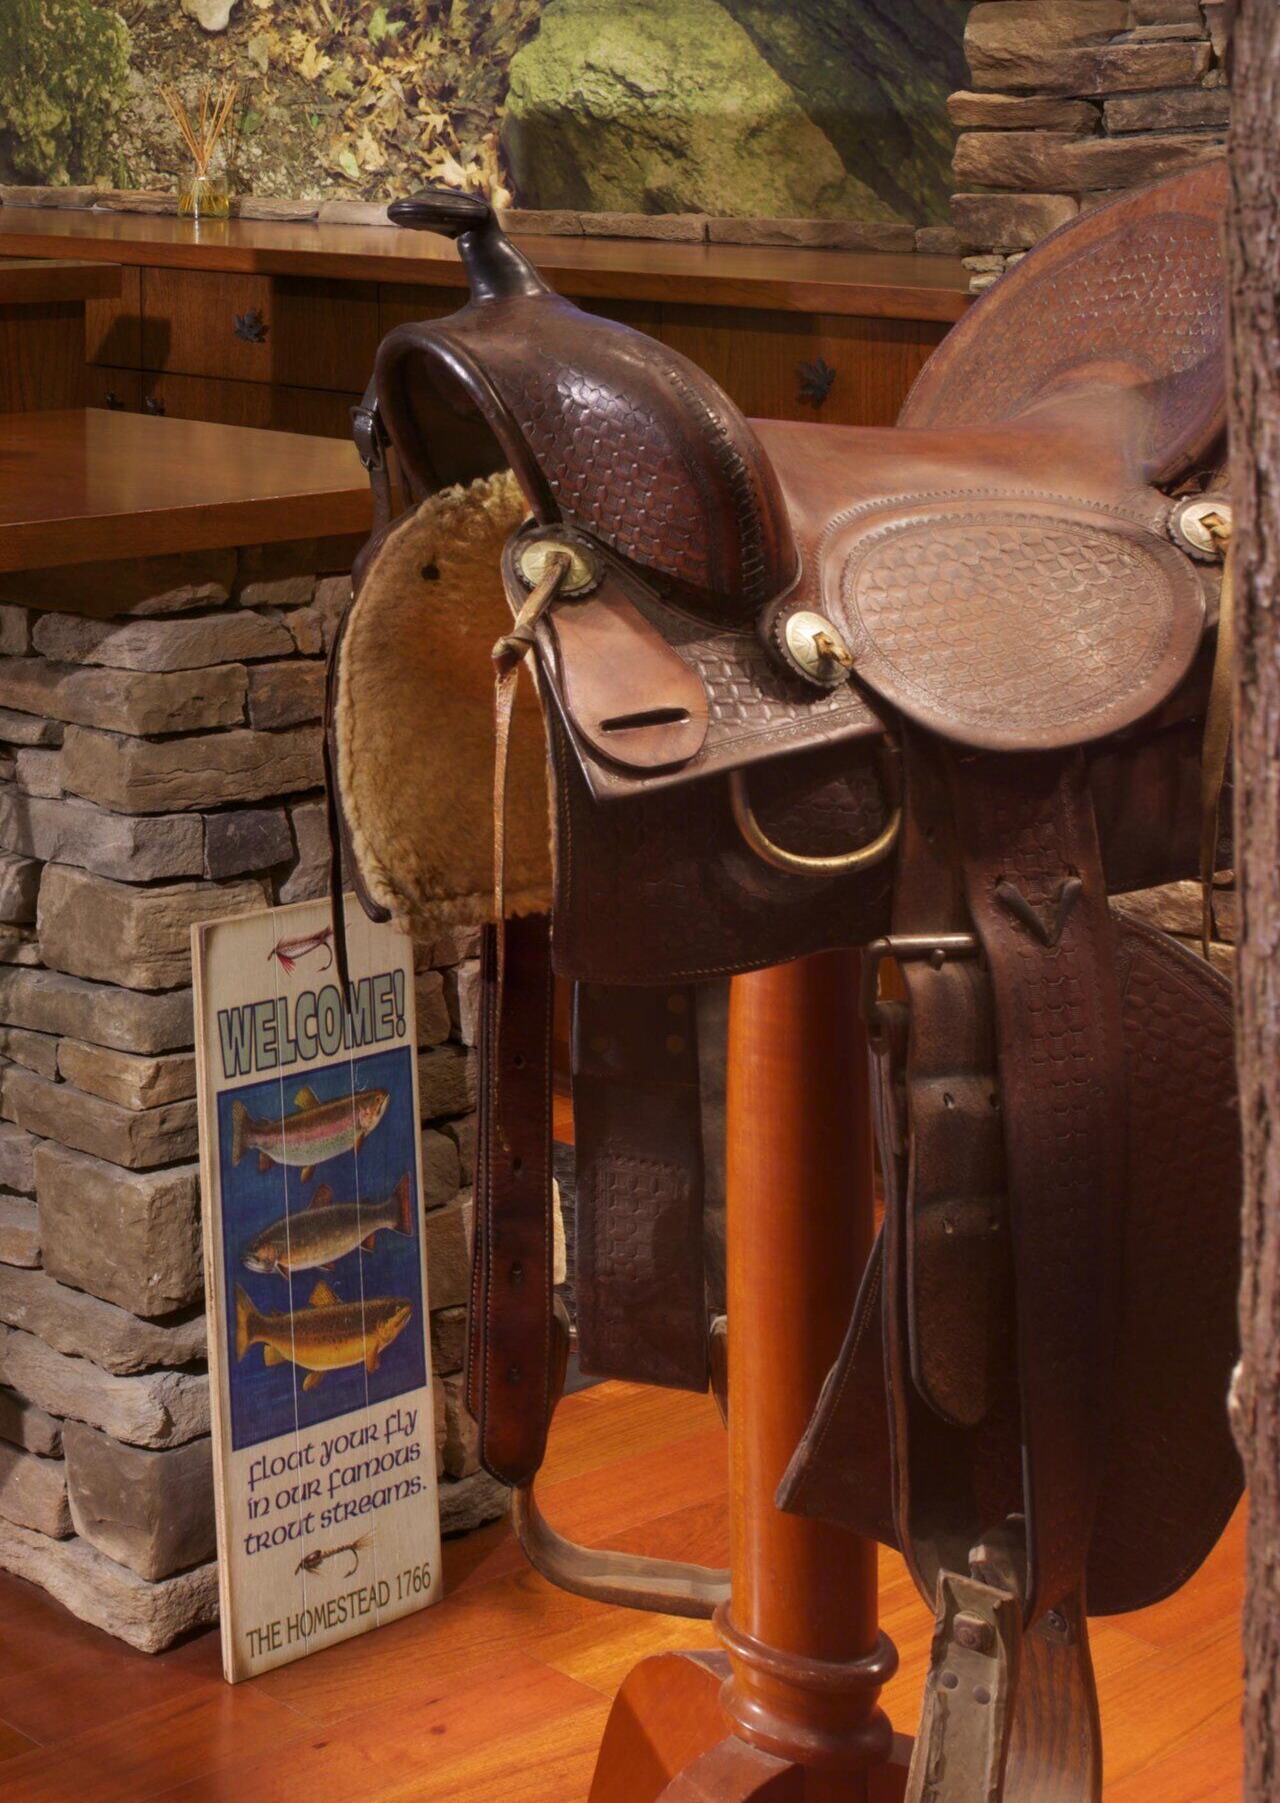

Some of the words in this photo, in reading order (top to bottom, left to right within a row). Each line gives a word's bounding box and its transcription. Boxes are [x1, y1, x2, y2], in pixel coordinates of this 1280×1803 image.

[217, 968, 407, 1079] WELCOME!
[247, 1443, 316, 1492] float
[320, 1422, 379, 1467] your
[383, 1408, 418, 1445] fly
[247, 1495, 270, 1520] in
[276, 1477, 321, 1510] our
[327, 1441, 421, 1500] famous
[243, 1516, 316, 1556] trout
[246, 1620, 282, 1658] THE
[287, 1580, 391, 1645] HOMESTEAD
[396, 1561, 431, 1600] 1766
